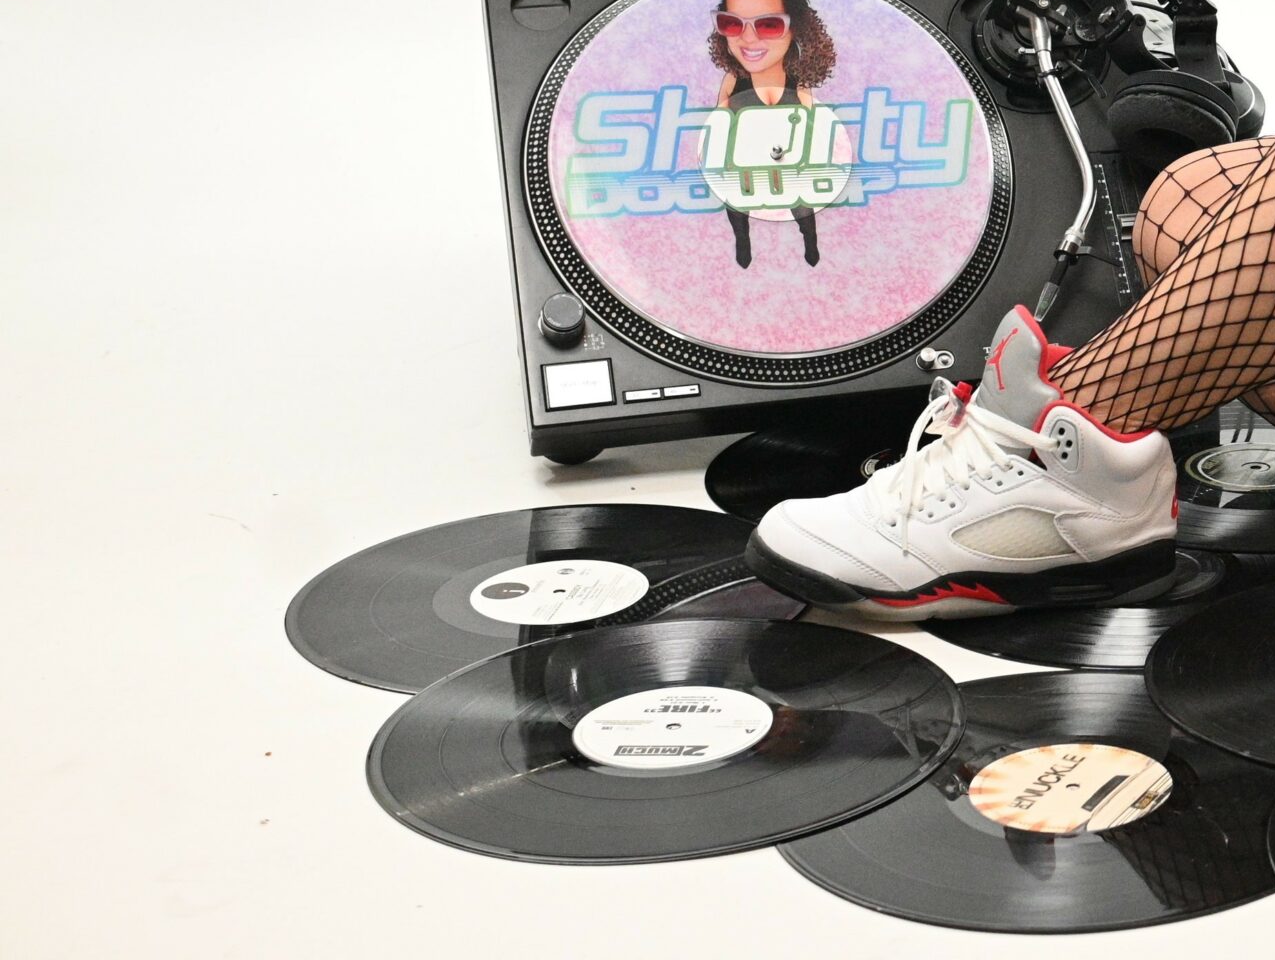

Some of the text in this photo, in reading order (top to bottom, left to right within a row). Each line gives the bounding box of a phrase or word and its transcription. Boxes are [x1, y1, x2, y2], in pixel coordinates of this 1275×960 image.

[574, 85, 974, 187] Shorty
[615, 744, 710, 756] 2 MUCH
